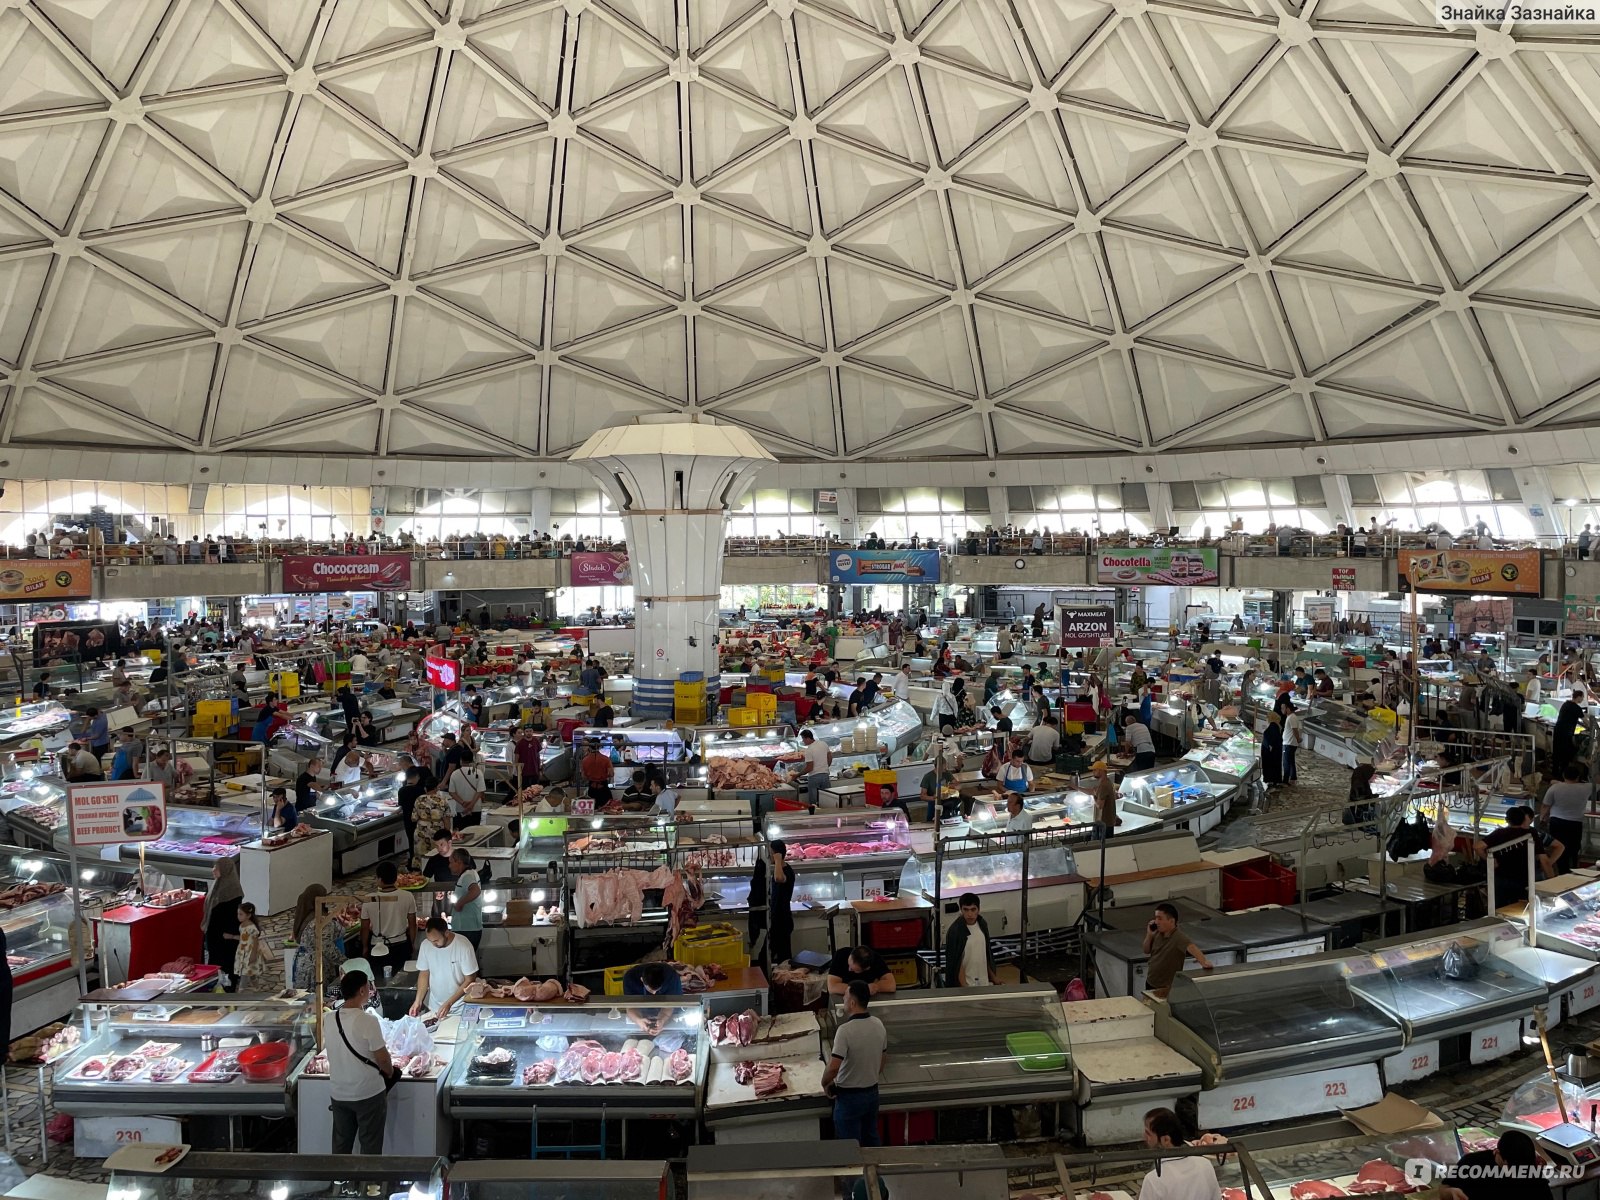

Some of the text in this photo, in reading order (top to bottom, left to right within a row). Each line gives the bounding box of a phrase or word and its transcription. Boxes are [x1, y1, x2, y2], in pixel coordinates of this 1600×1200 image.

[1103, 556, 1151, 567] Chocotella
[313, 562, 380, 574] Chococream
[1471, 574, 1490, 584] BILAN
[25, 582, 44, 592] BILAN
[1068, 622, 1108, 632] ARZON
[75, 794, 119, 806] MOL GO'SHTI
[77, 825, 120, 835] BEEF PRODUCT
[865, 888, 881, 897] 245
[1583, 986, 1594, 999] 220
[1482, 1036, 1498, 1050] 221
[1412, 1056, 1429, 1070] 222
[1325, 1082, 1347, 1097] 223
[1233, 1096, 1255, 1111] 224
[116, 1130, 142, 1143] 230
